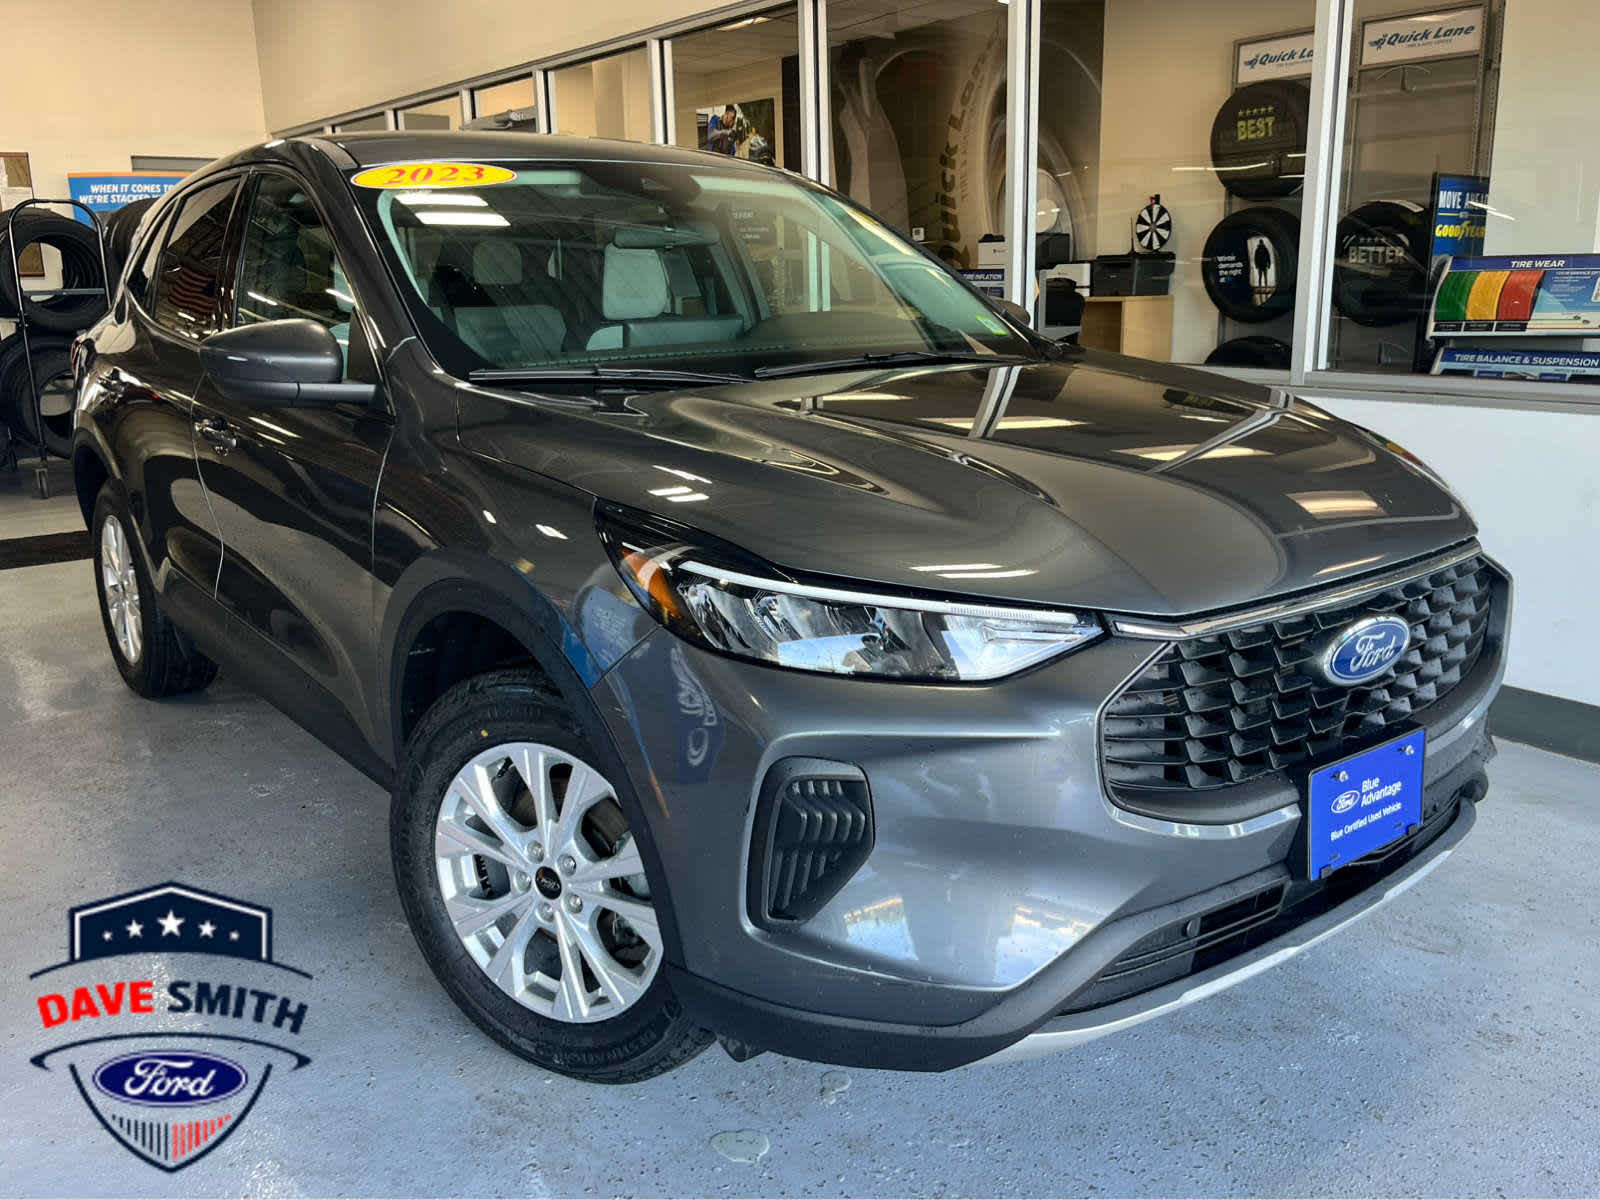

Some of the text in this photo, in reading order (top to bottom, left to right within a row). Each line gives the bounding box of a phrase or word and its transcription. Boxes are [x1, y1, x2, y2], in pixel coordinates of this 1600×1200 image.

[1387, 25, 1475, 46] Quick Lane
[1259, 49, 1297, 65] Quick
[1298, 48, 1313, 59] La
[1237, 117, 1275, 141] BEST
[384, 166, 485, 185] 2023
[90, 184, 118, 193] WHEN
[120, 184, 129, 193] IT
[131, 184, 161, 193] COMES
[80, 194, 110, 204] WE'RE
[1438, 190, 1462, 209] MOVE
[1435, 221, 1486, 240] GOODYEAR
[1348, 246, 1404, 264] BETTER
[1511, 260, 1566, 268] TIRE WEAR
[1454, 354, 1600, 367] TIRE BALANCE & SUSPENSION
[1350, 631, 1396, 673] Ford
[1361, 777, 1380, 793] Blue
[1336, 781, 1402, 811] Ford Advantage
[1330, 801, 1402, 841] Blue Certified Used Vehicle
